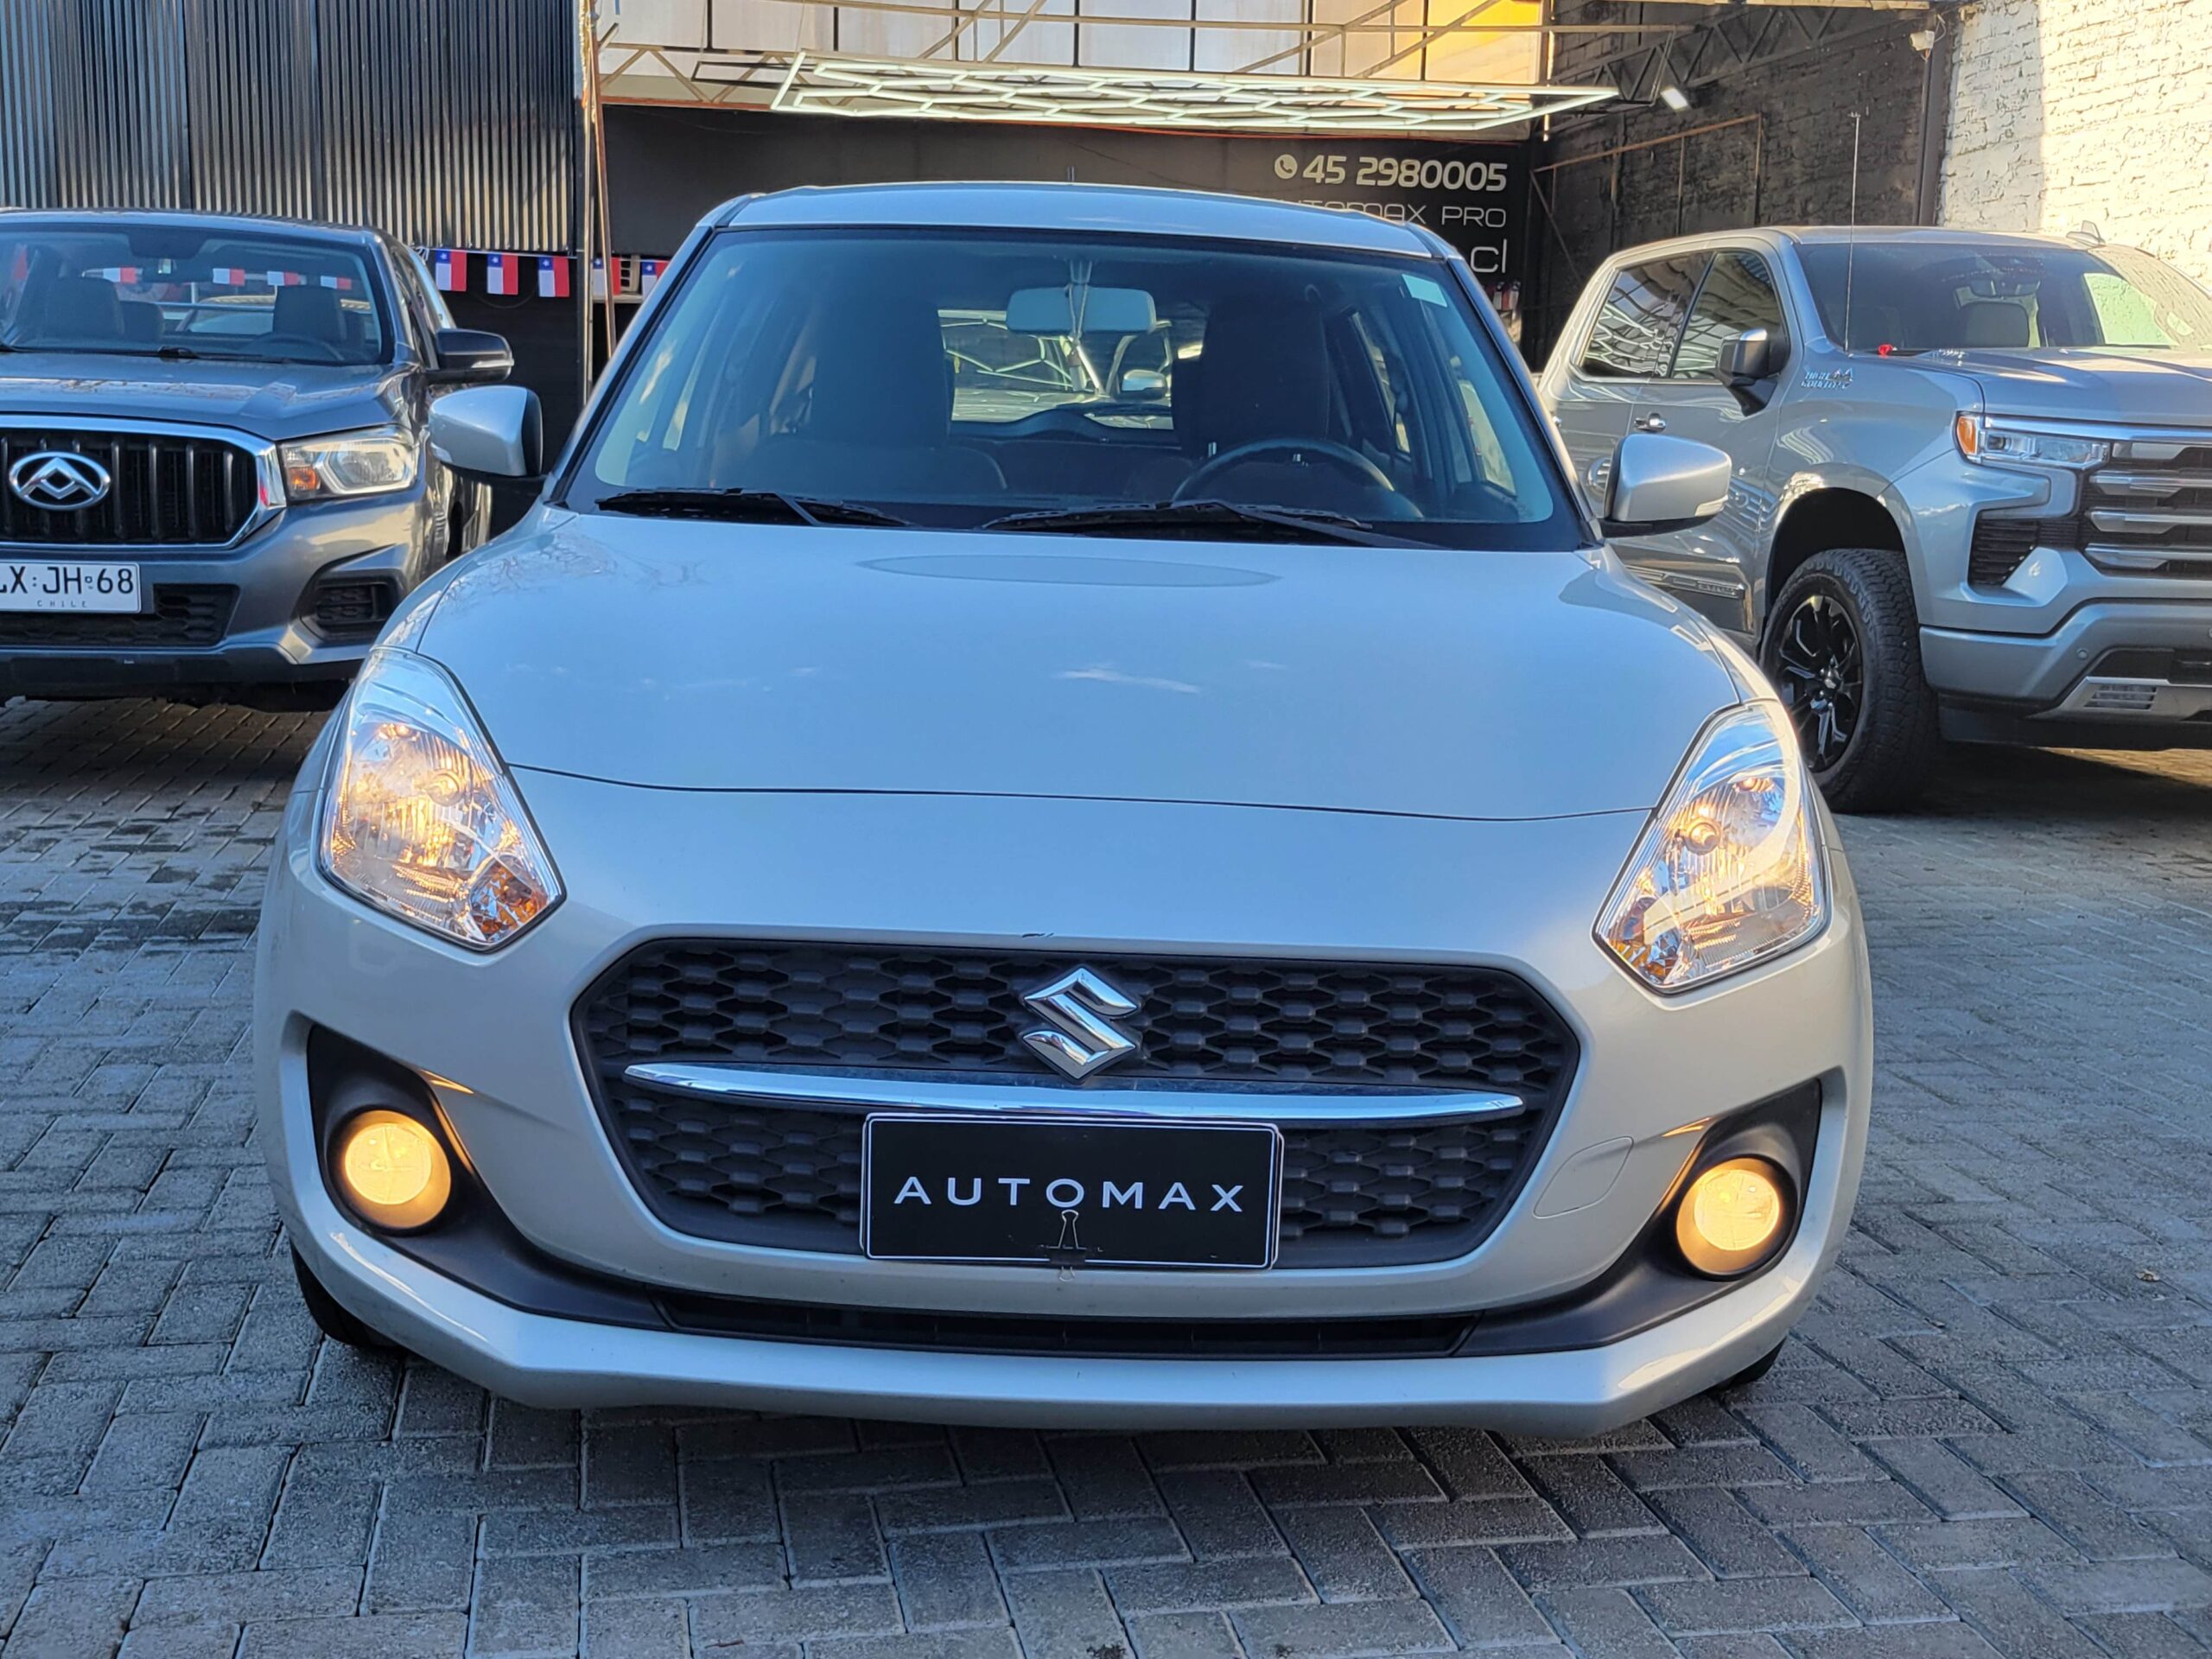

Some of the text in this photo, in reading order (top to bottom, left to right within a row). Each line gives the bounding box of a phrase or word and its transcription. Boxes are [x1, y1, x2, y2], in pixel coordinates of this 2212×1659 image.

[1303, 155, 1508, 191] 45 2980005
[1441, 206, 1506, 229] PRO
[37, 600, 88, 608] CHILE
[893, 1176, 1243, 1212] AUTOMAX
